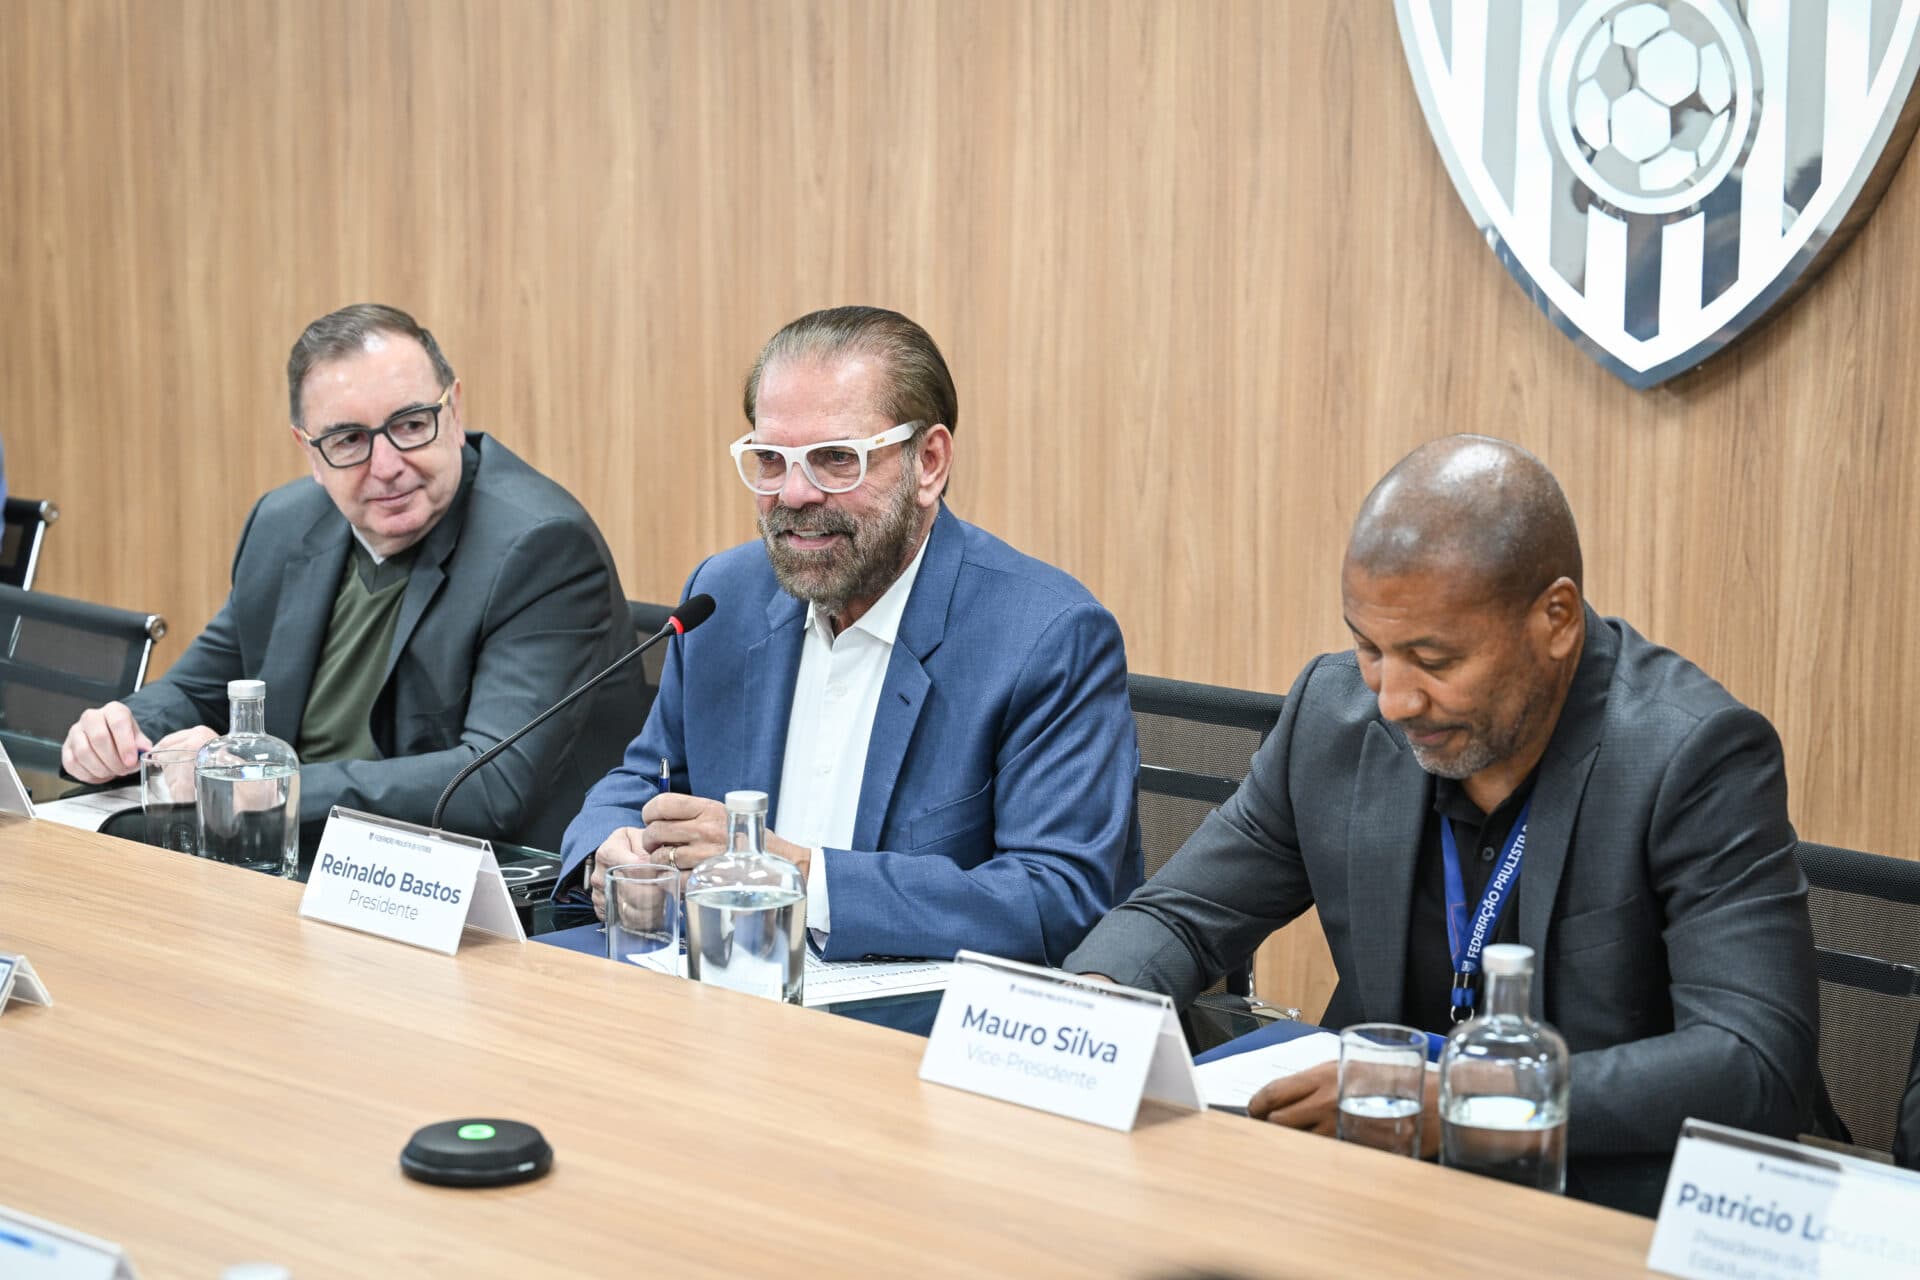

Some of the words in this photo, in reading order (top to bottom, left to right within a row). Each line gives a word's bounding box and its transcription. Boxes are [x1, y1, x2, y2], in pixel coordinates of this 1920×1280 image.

[321, 853, 396, 888] Reinaldo
[400, 872, 462, 904] Bastos
[348, 889, 419, 920] Presidente
[1467, 890, 1500, 959] FEDERAÇÃO
[961, 1004, 1047, 1045] Mauro
[1053, 1025, 1118, 1063] Silva
[967, 1041, 1097, 1090] Vice-Presidente
[1677, 1182, 1793, 1234] Patricio
